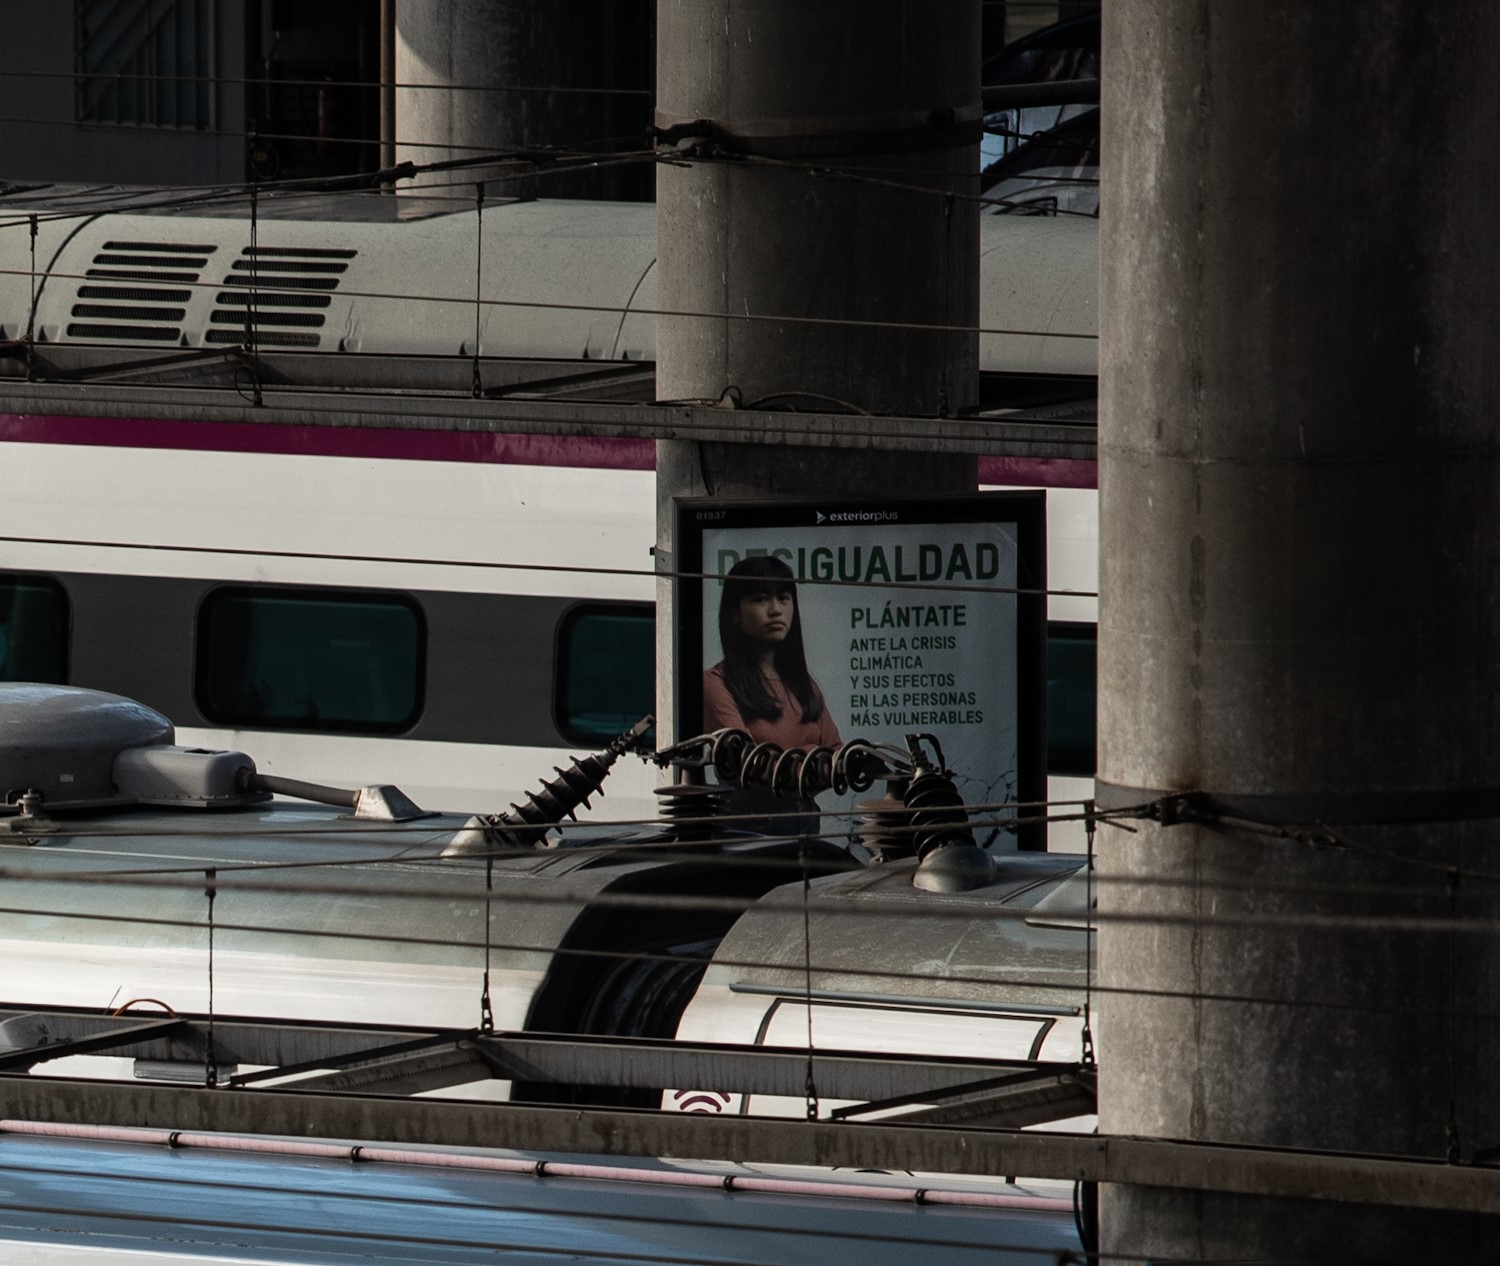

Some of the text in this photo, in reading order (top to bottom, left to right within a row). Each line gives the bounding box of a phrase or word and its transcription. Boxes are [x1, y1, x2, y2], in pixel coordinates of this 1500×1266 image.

[829, 511, 899, 522] exteriorplus
[851, 600, 967, 629] PLÁNTATE
[850, 636, 956, 651] ANTE LA CRISIS
[850, 653, 923, 670] CLIMÁTICA
[850, 674, 955, 689] Y SUS EFECTOS
[851, 692, 976, 708] EN LAS PERSONAS
[851, 710, 983, 726] MÁS VULNERABLES
